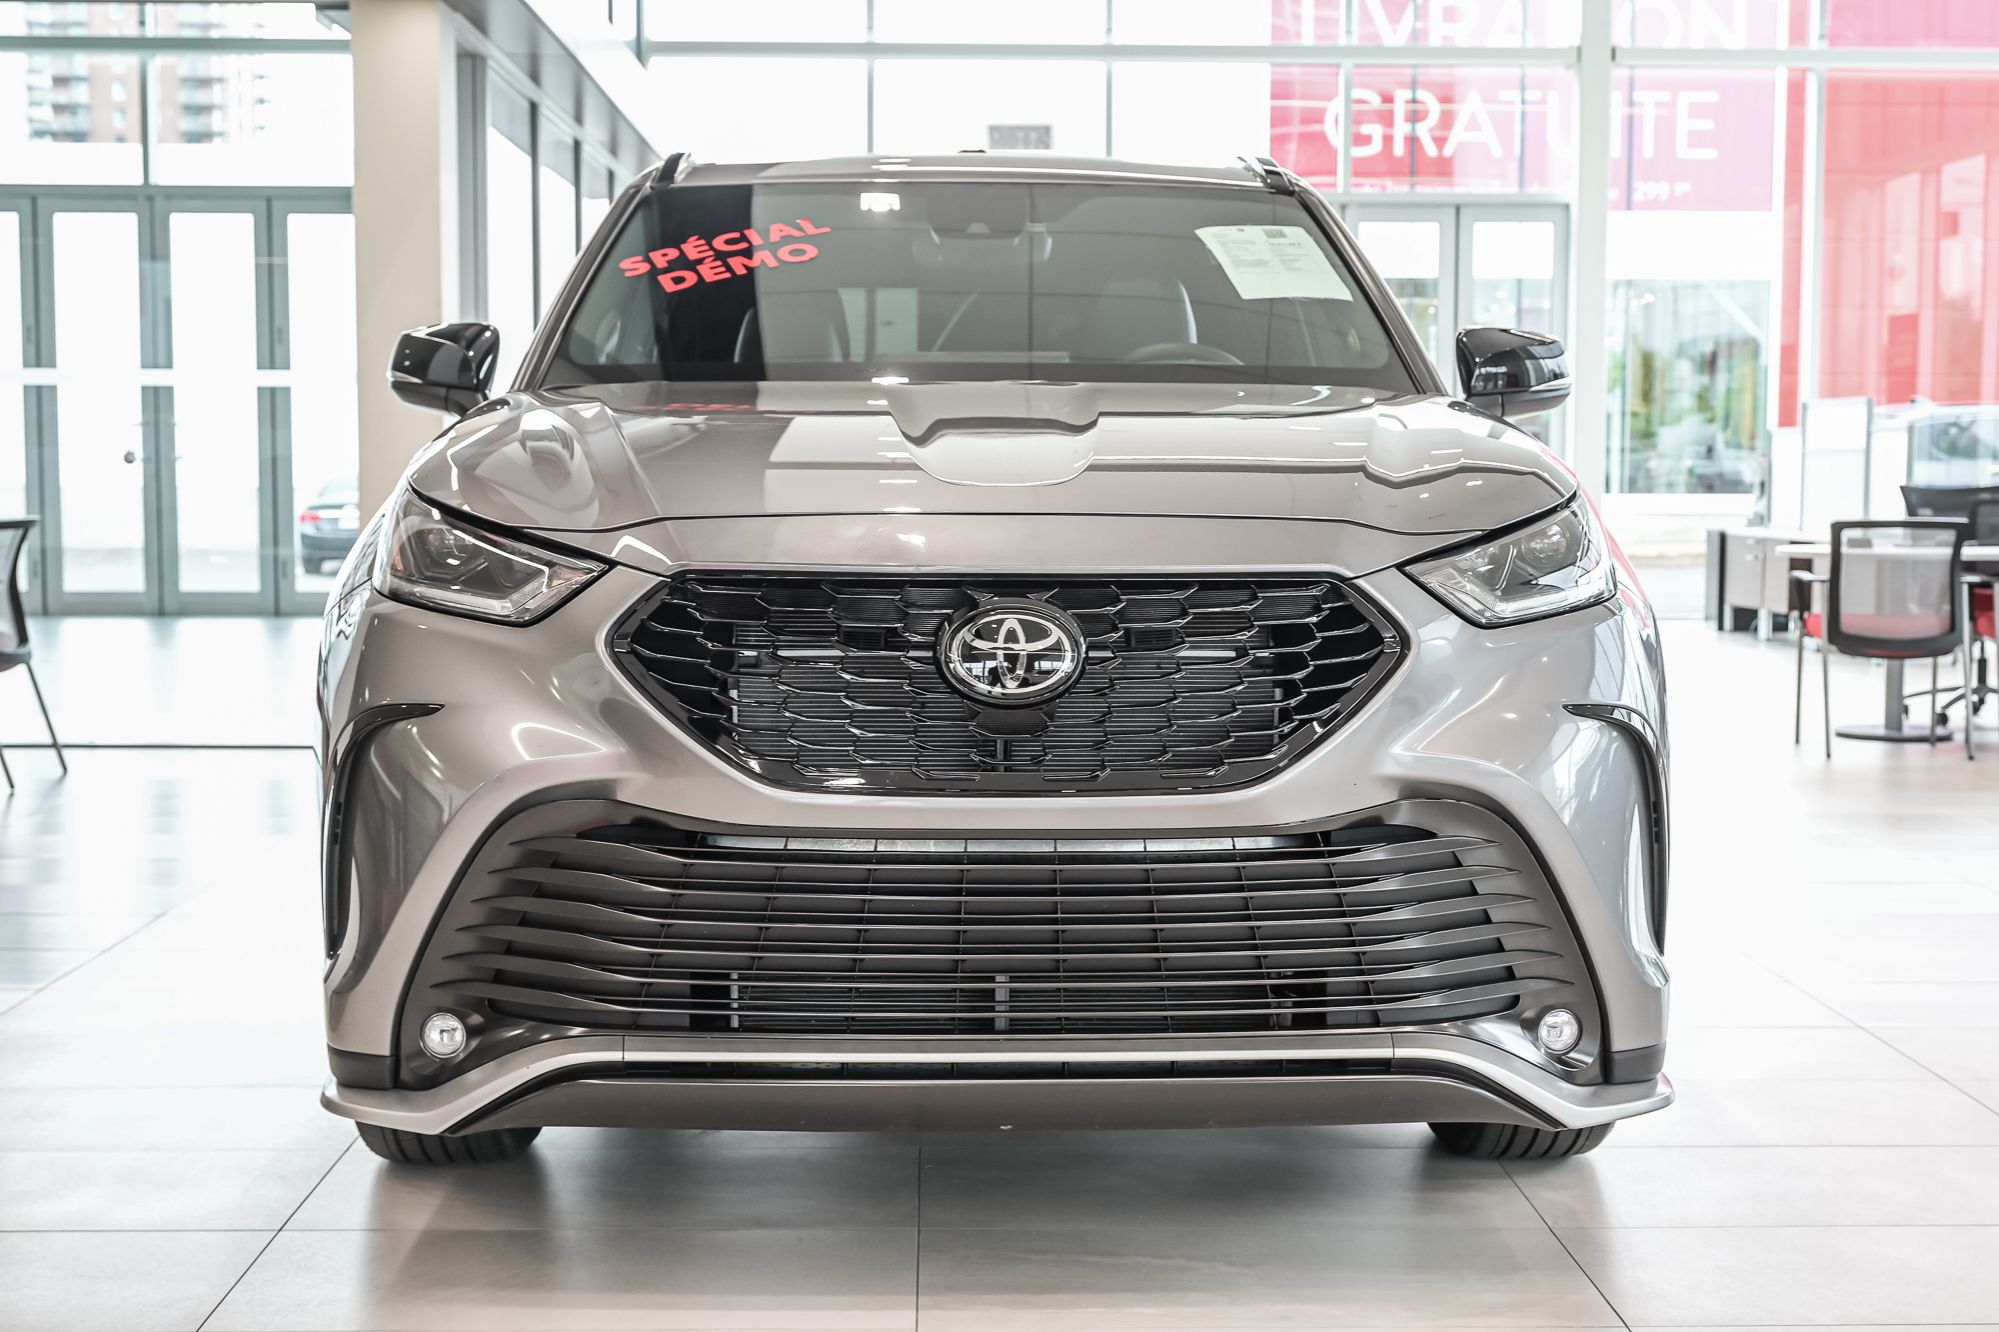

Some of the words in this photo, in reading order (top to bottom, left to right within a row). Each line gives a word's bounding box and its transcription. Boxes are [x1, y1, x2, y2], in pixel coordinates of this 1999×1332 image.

[1302, 0, 1746, 48] LVRAON
[1324, 88, 1720, 160] GRATUITE
[618, 217, 832, 278] SPÉCIAL
[657, 243, 819, 293] DÉMO
